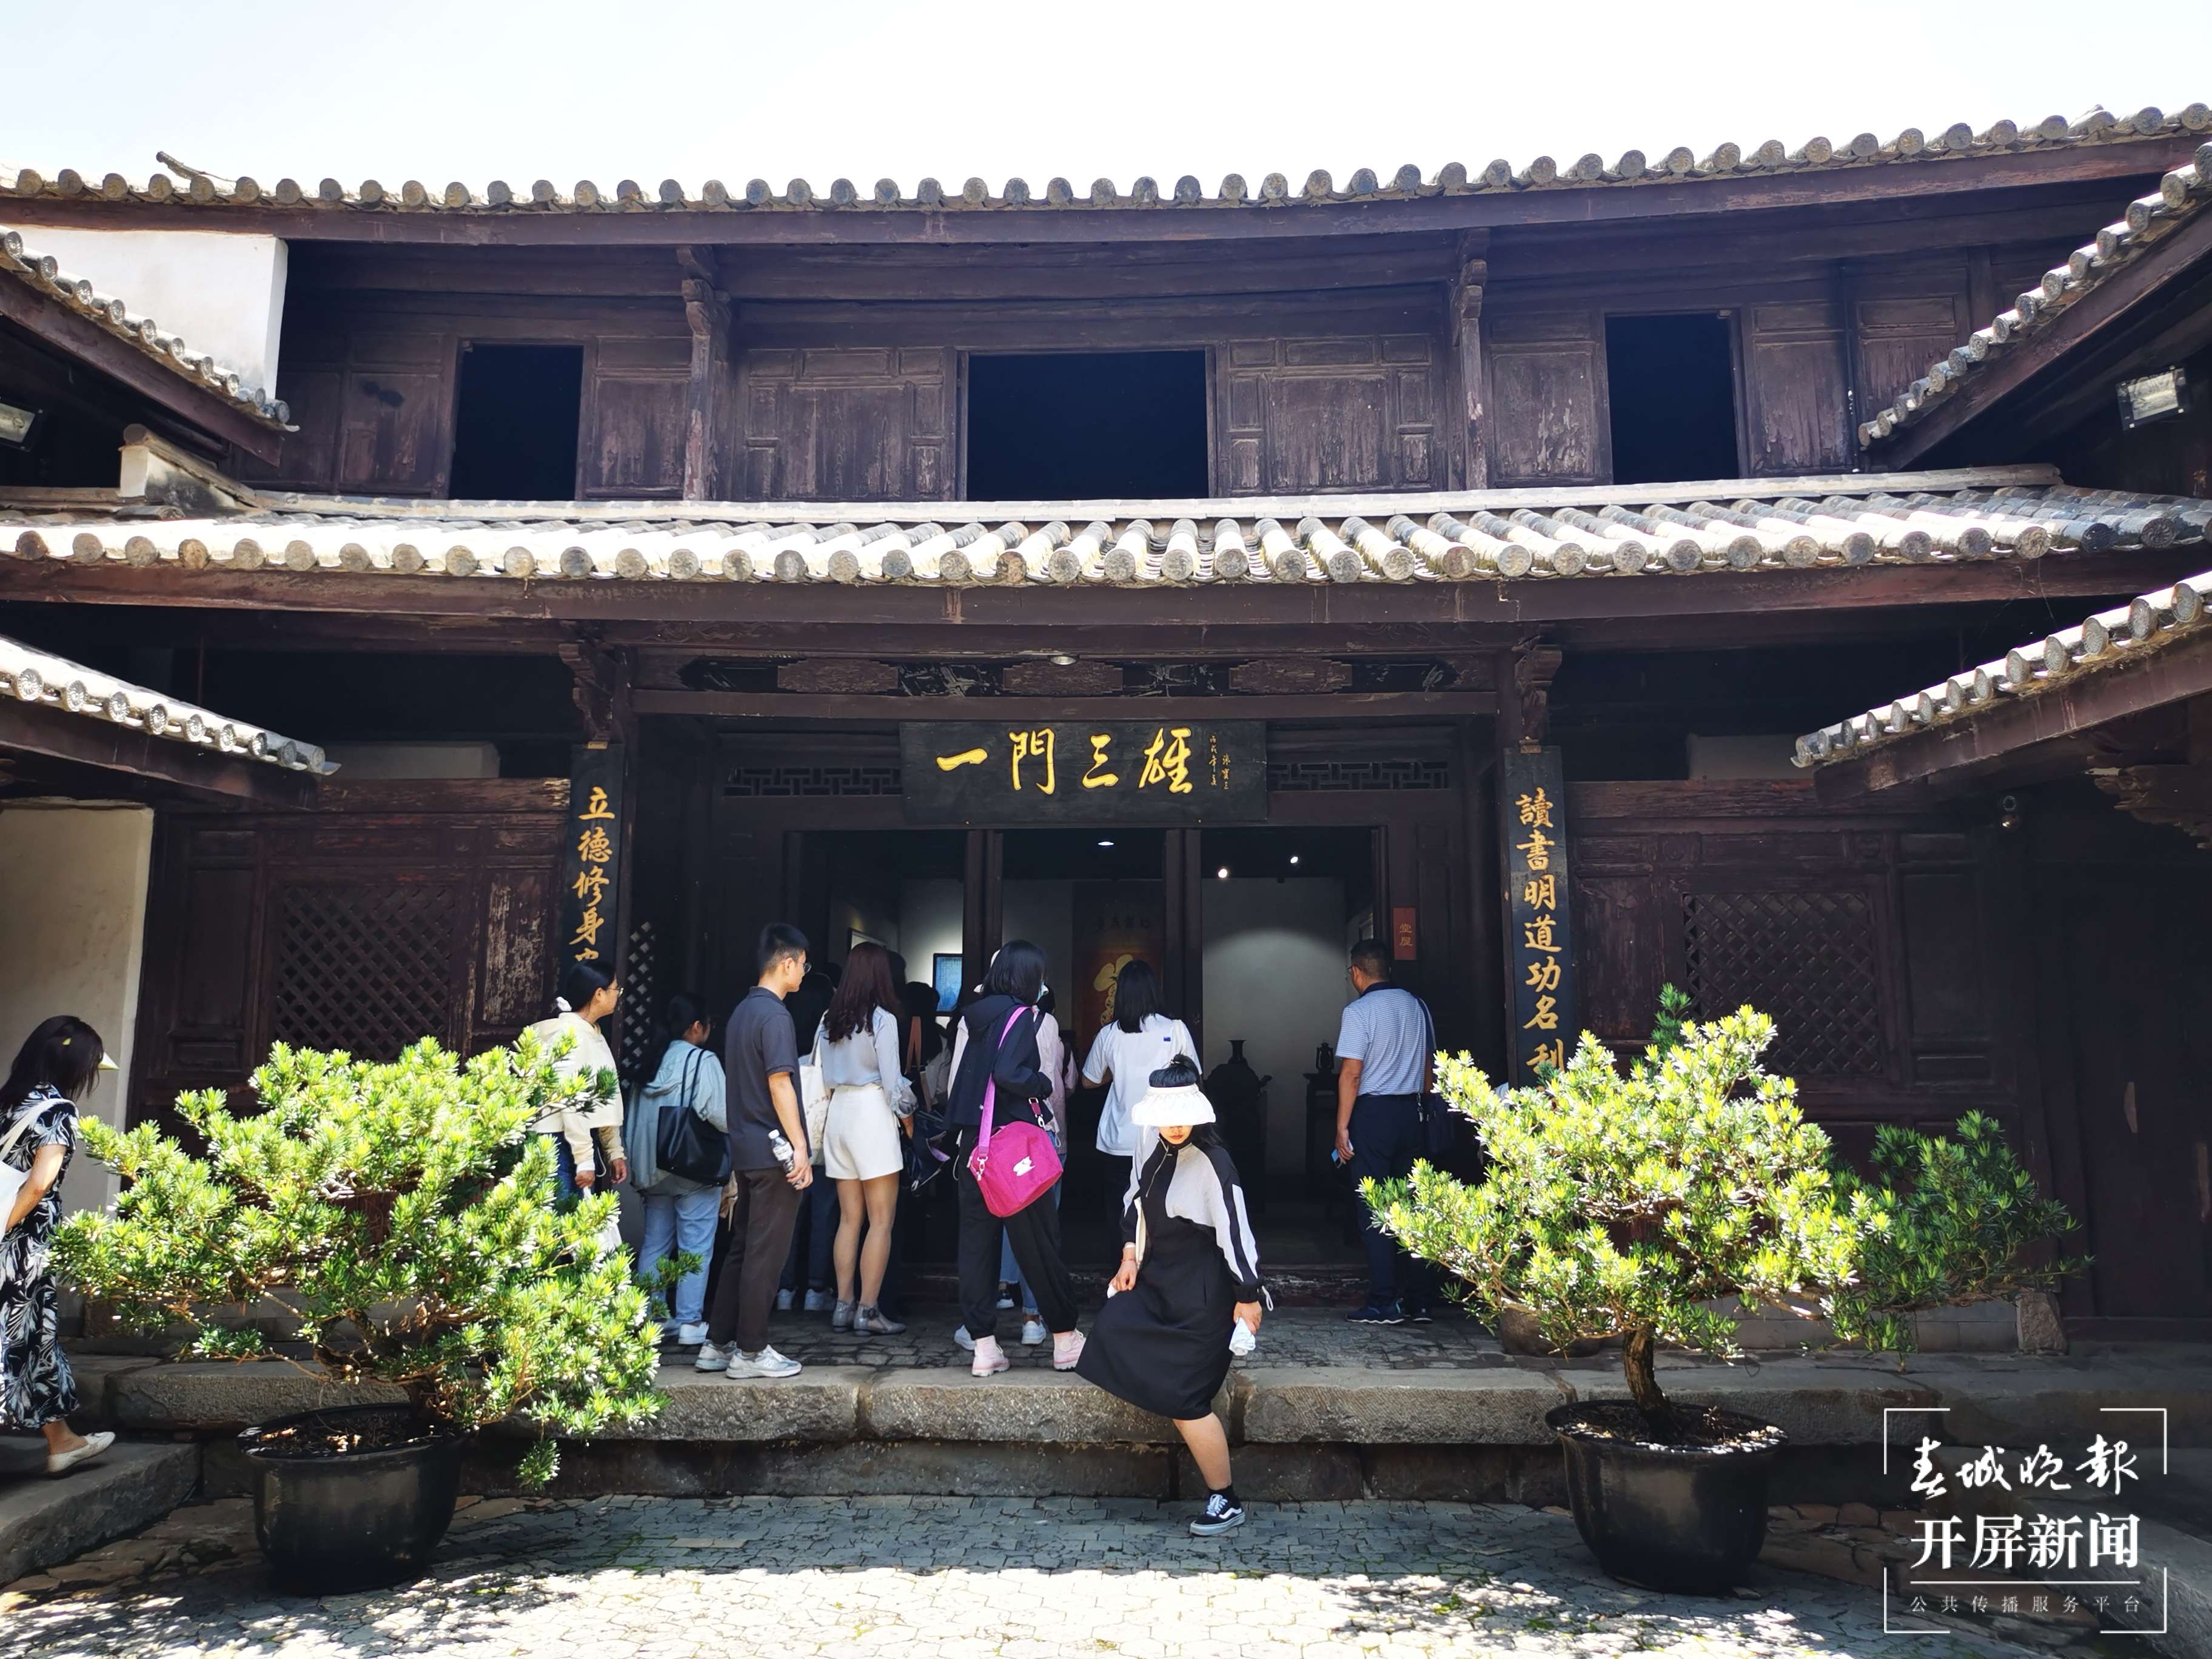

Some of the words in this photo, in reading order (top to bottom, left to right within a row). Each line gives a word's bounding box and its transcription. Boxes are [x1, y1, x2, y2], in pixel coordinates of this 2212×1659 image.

[937, 728, 1193, 795] 一門三雄
[1515, 787, 1565, 1091] 讀書明道功名利
